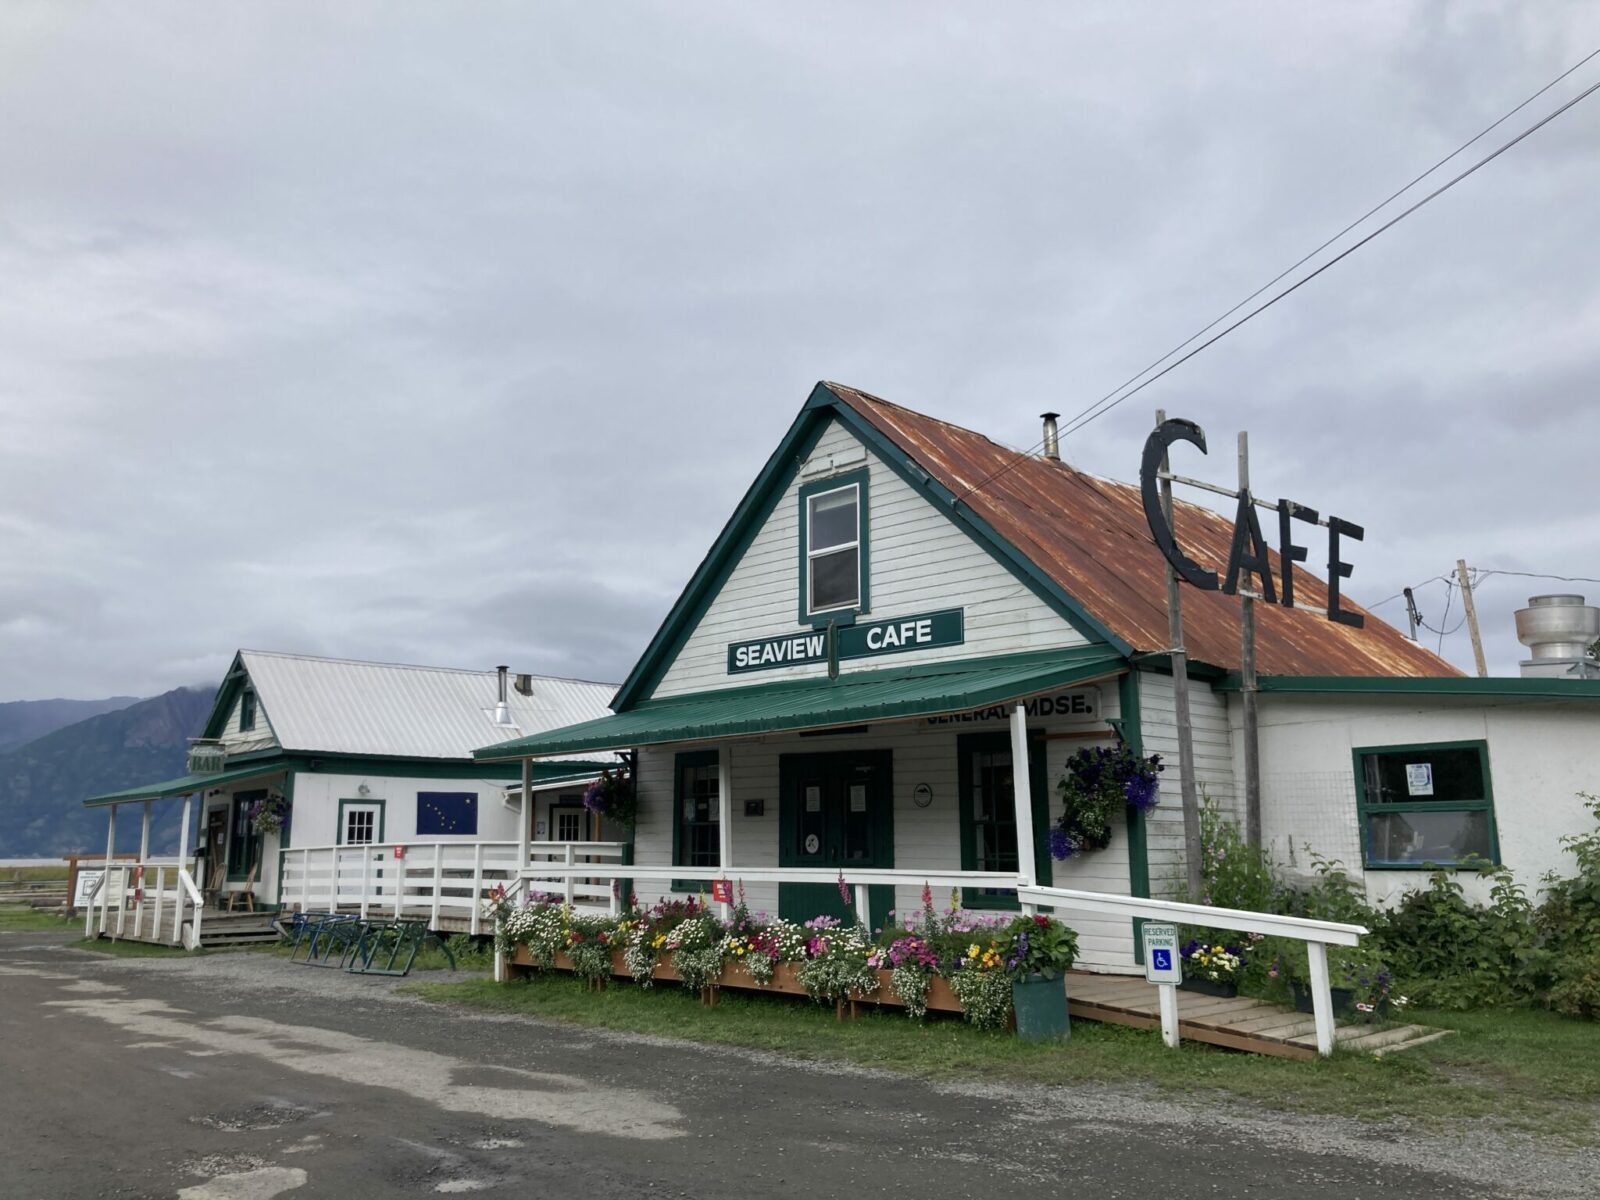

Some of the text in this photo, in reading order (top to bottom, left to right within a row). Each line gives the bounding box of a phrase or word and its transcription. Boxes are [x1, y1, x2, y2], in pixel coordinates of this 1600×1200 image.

[1140, 418, 1364, 629] CAFE
[735, 619, 932, 667] SEAVIEW CAFE
[192, 756, 221, 770] BAR
[1144, 927, 1175, 936] RESERVED
[1148, 938, 1173, 946] PARKING
